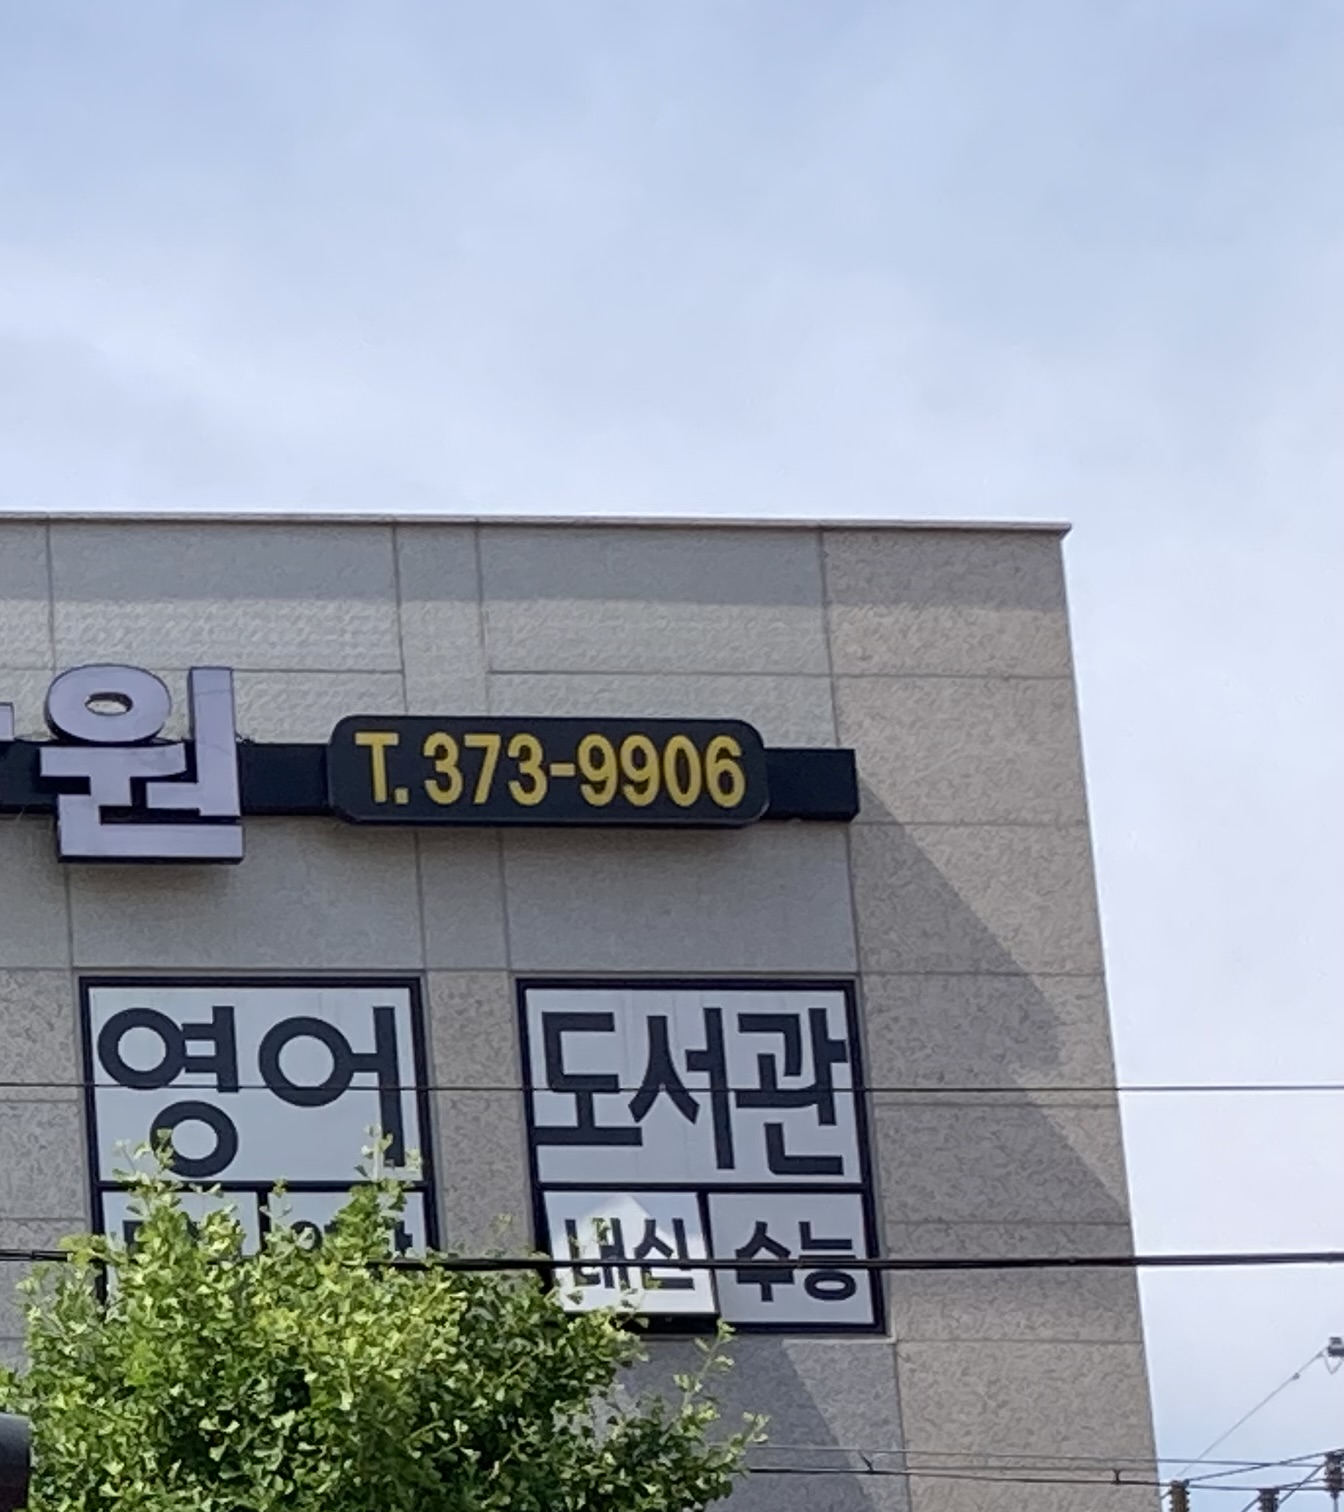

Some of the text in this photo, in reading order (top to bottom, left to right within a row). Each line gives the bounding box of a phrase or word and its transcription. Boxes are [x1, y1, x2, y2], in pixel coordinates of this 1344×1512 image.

[97, 1004, 406, 1178] 영어
[534, 1006, 850, 1176] 도서관
[564, 1217, 858, 1303] 내신 수능
